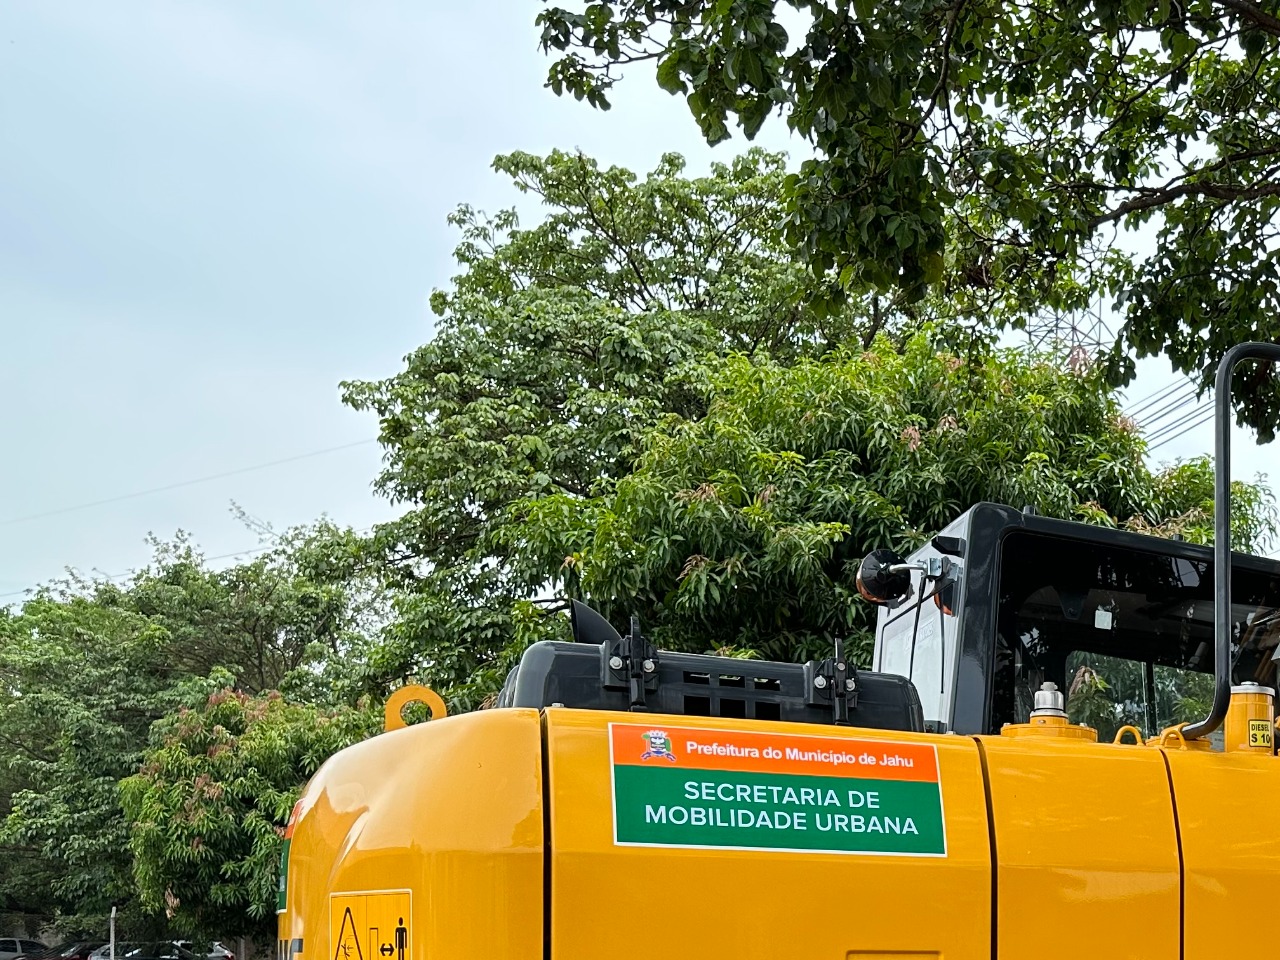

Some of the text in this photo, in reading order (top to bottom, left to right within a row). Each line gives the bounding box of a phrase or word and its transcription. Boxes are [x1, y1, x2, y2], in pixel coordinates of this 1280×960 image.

[686, 741, 914, 767] Prefeitura do Município de Jahu
[684, 781, 880, 809] SECRETARIA DE
[645, 805, 919, 834] MOBILIDADE URBANA
